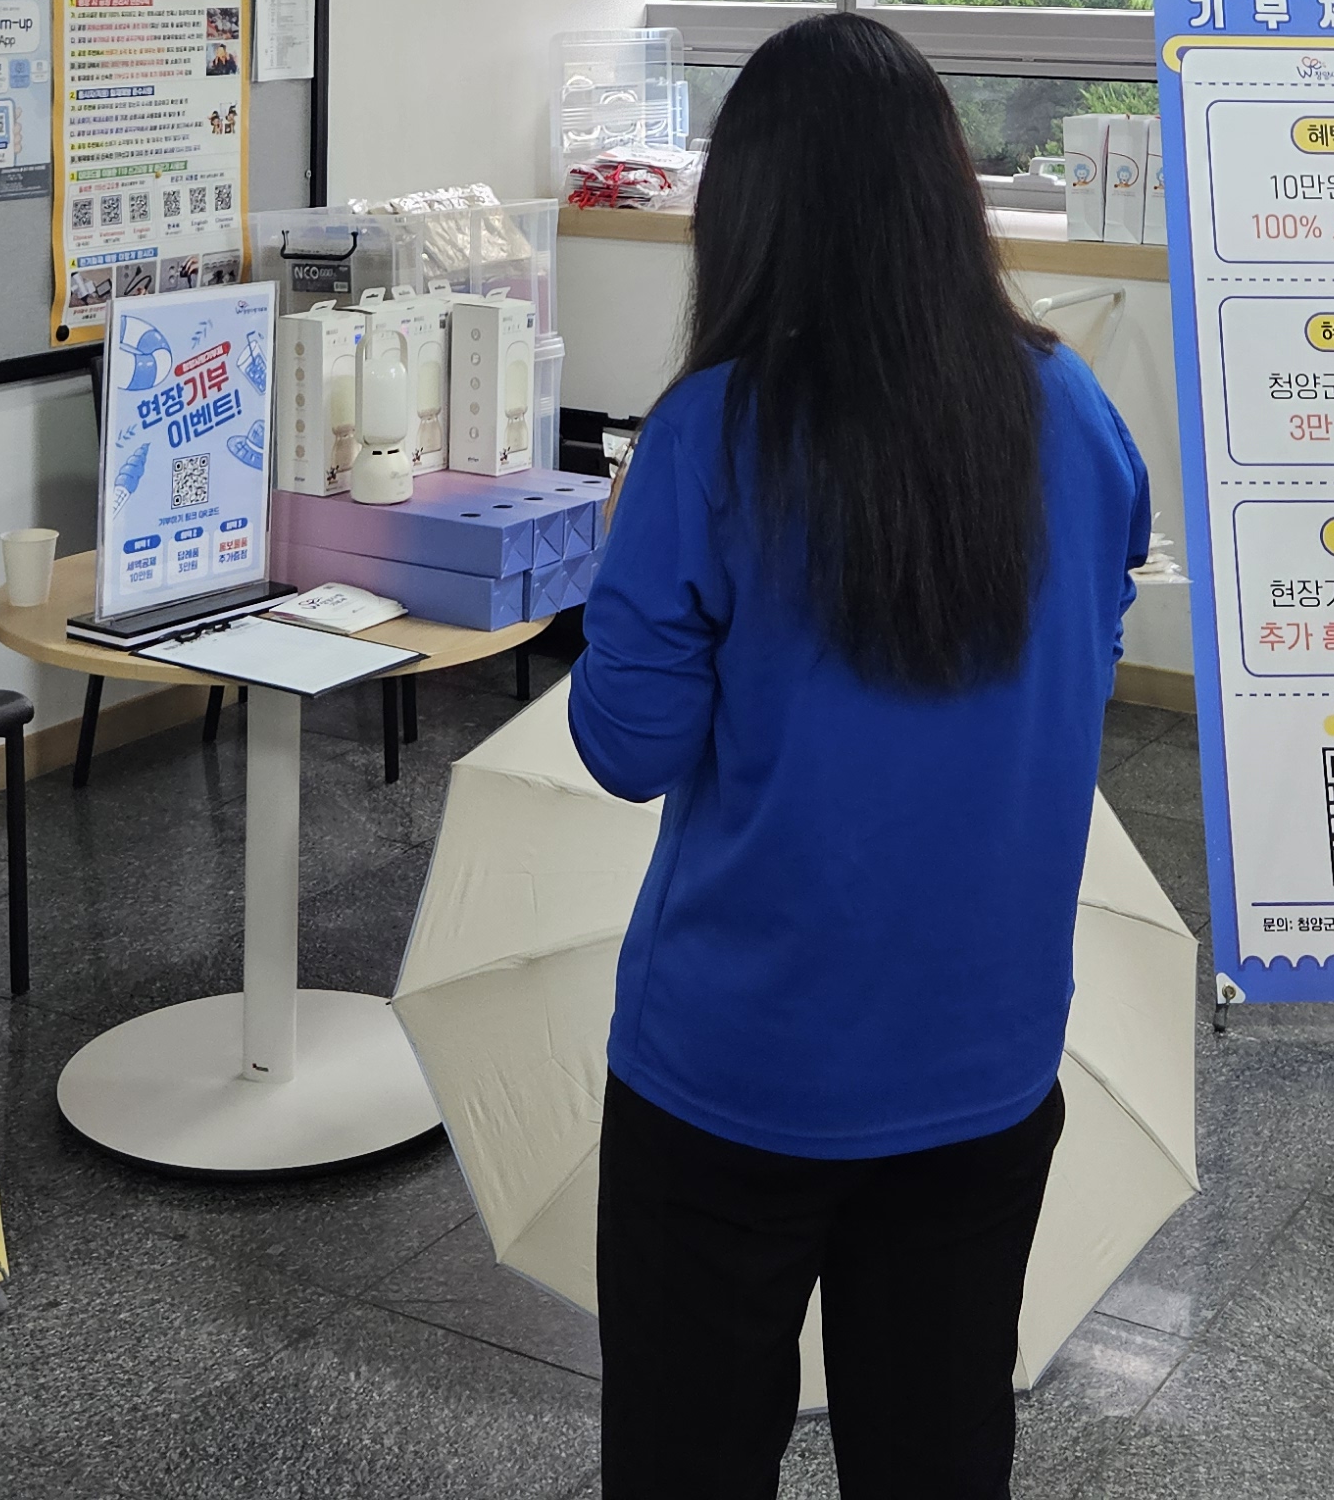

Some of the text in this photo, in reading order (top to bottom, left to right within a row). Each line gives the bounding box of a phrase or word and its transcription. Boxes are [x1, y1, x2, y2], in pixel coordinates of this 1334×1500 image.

[0, 35, 16, 48] App
[1252, 214, 1322, 239] 100%
[137, 361, 229, 430] 현장기부
[168, 389, 242, 448] 이벤트!
[1289, 413, 1332, 440] 3만
[1259, 622, 1313, 651] 추가
[1263, 917, 1293, 932] 문의:
